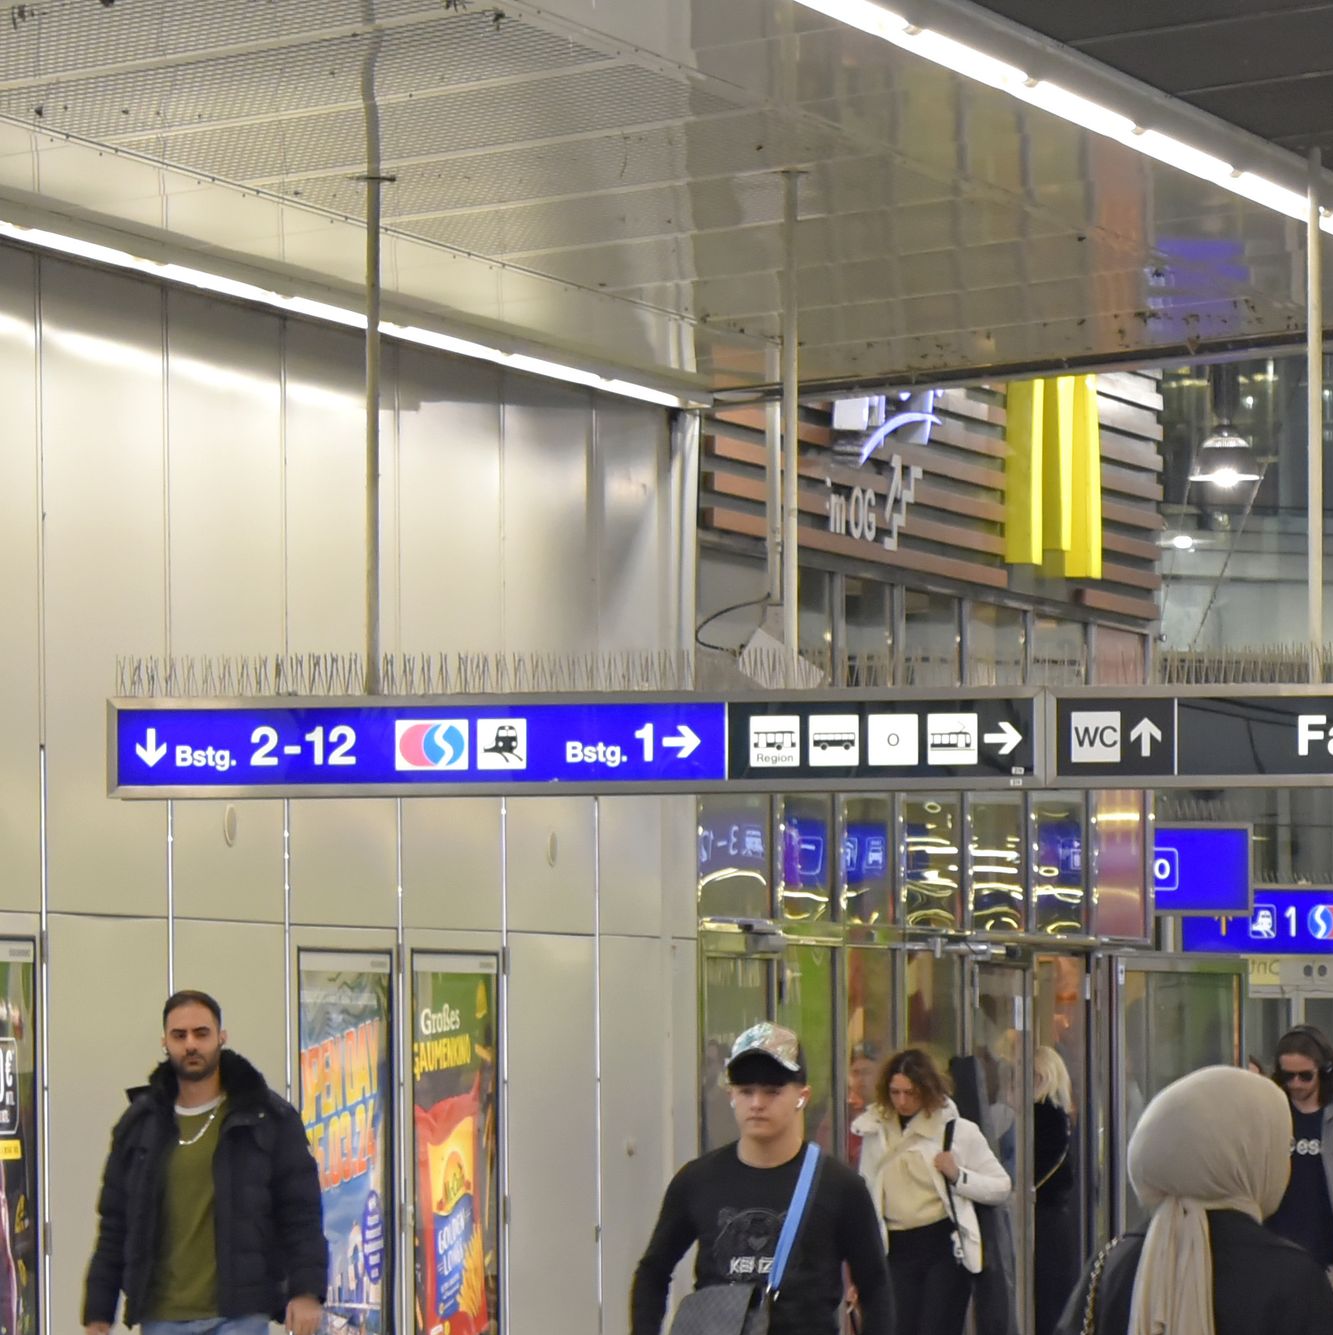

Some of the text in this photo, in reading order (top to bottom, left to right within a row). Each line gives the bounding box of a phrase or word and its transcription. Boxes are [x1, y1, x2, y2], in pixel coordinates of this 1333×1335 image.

[175, 725, 356, 771] Bstg. 2-12
[565, 723, 653, 766] Bstg. 1
[1074, 725, 1120, 749] WC
[756, 753, 794, 766] Region
[1285, 906, 1297, 937] 1
[420, 1003, 461, 1036] Großes
[730, 1256, 776, 1275] KENZ
